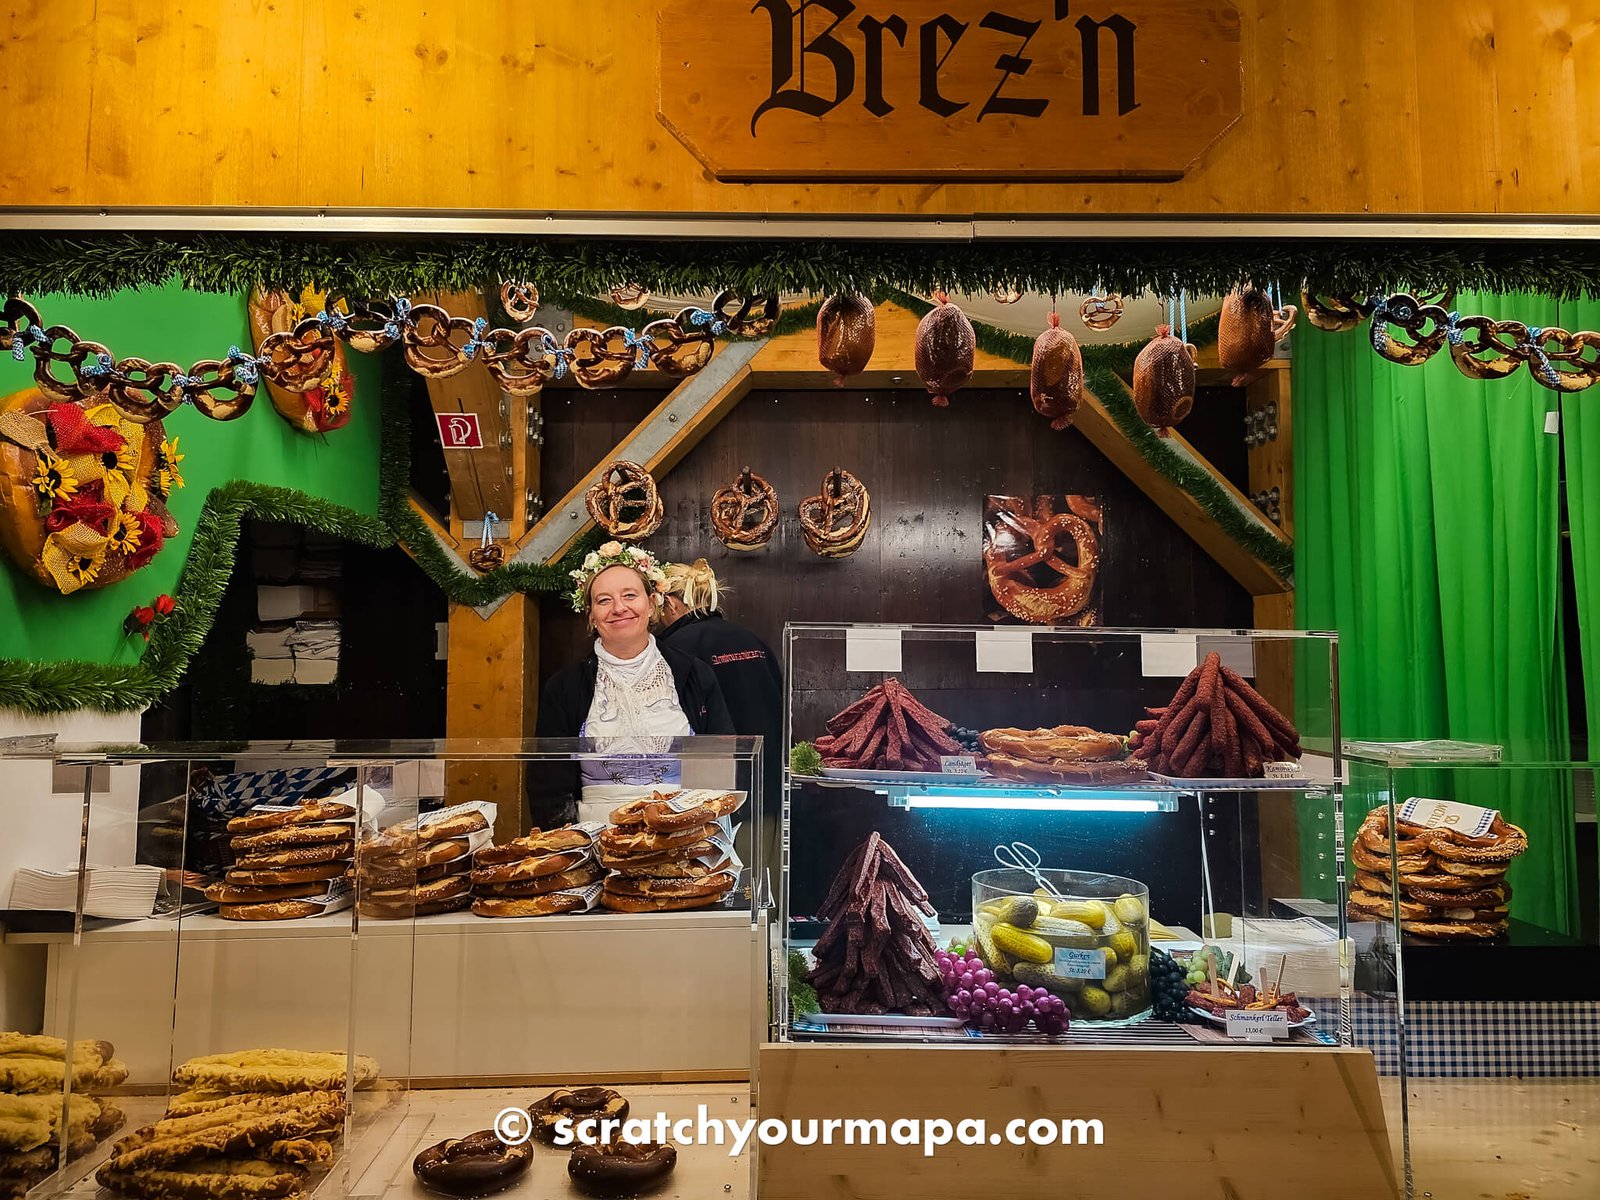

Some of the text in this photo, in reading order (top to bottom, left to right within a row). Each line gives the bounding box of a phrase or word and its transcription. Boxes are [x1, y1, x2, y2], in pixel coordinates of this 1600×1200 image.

[750, 0, 1141, 137] Brez'n
[1068, 951, 1091, 960] Gurken
[1229, 1013, 1283, 1022] Schmankerl Teller
